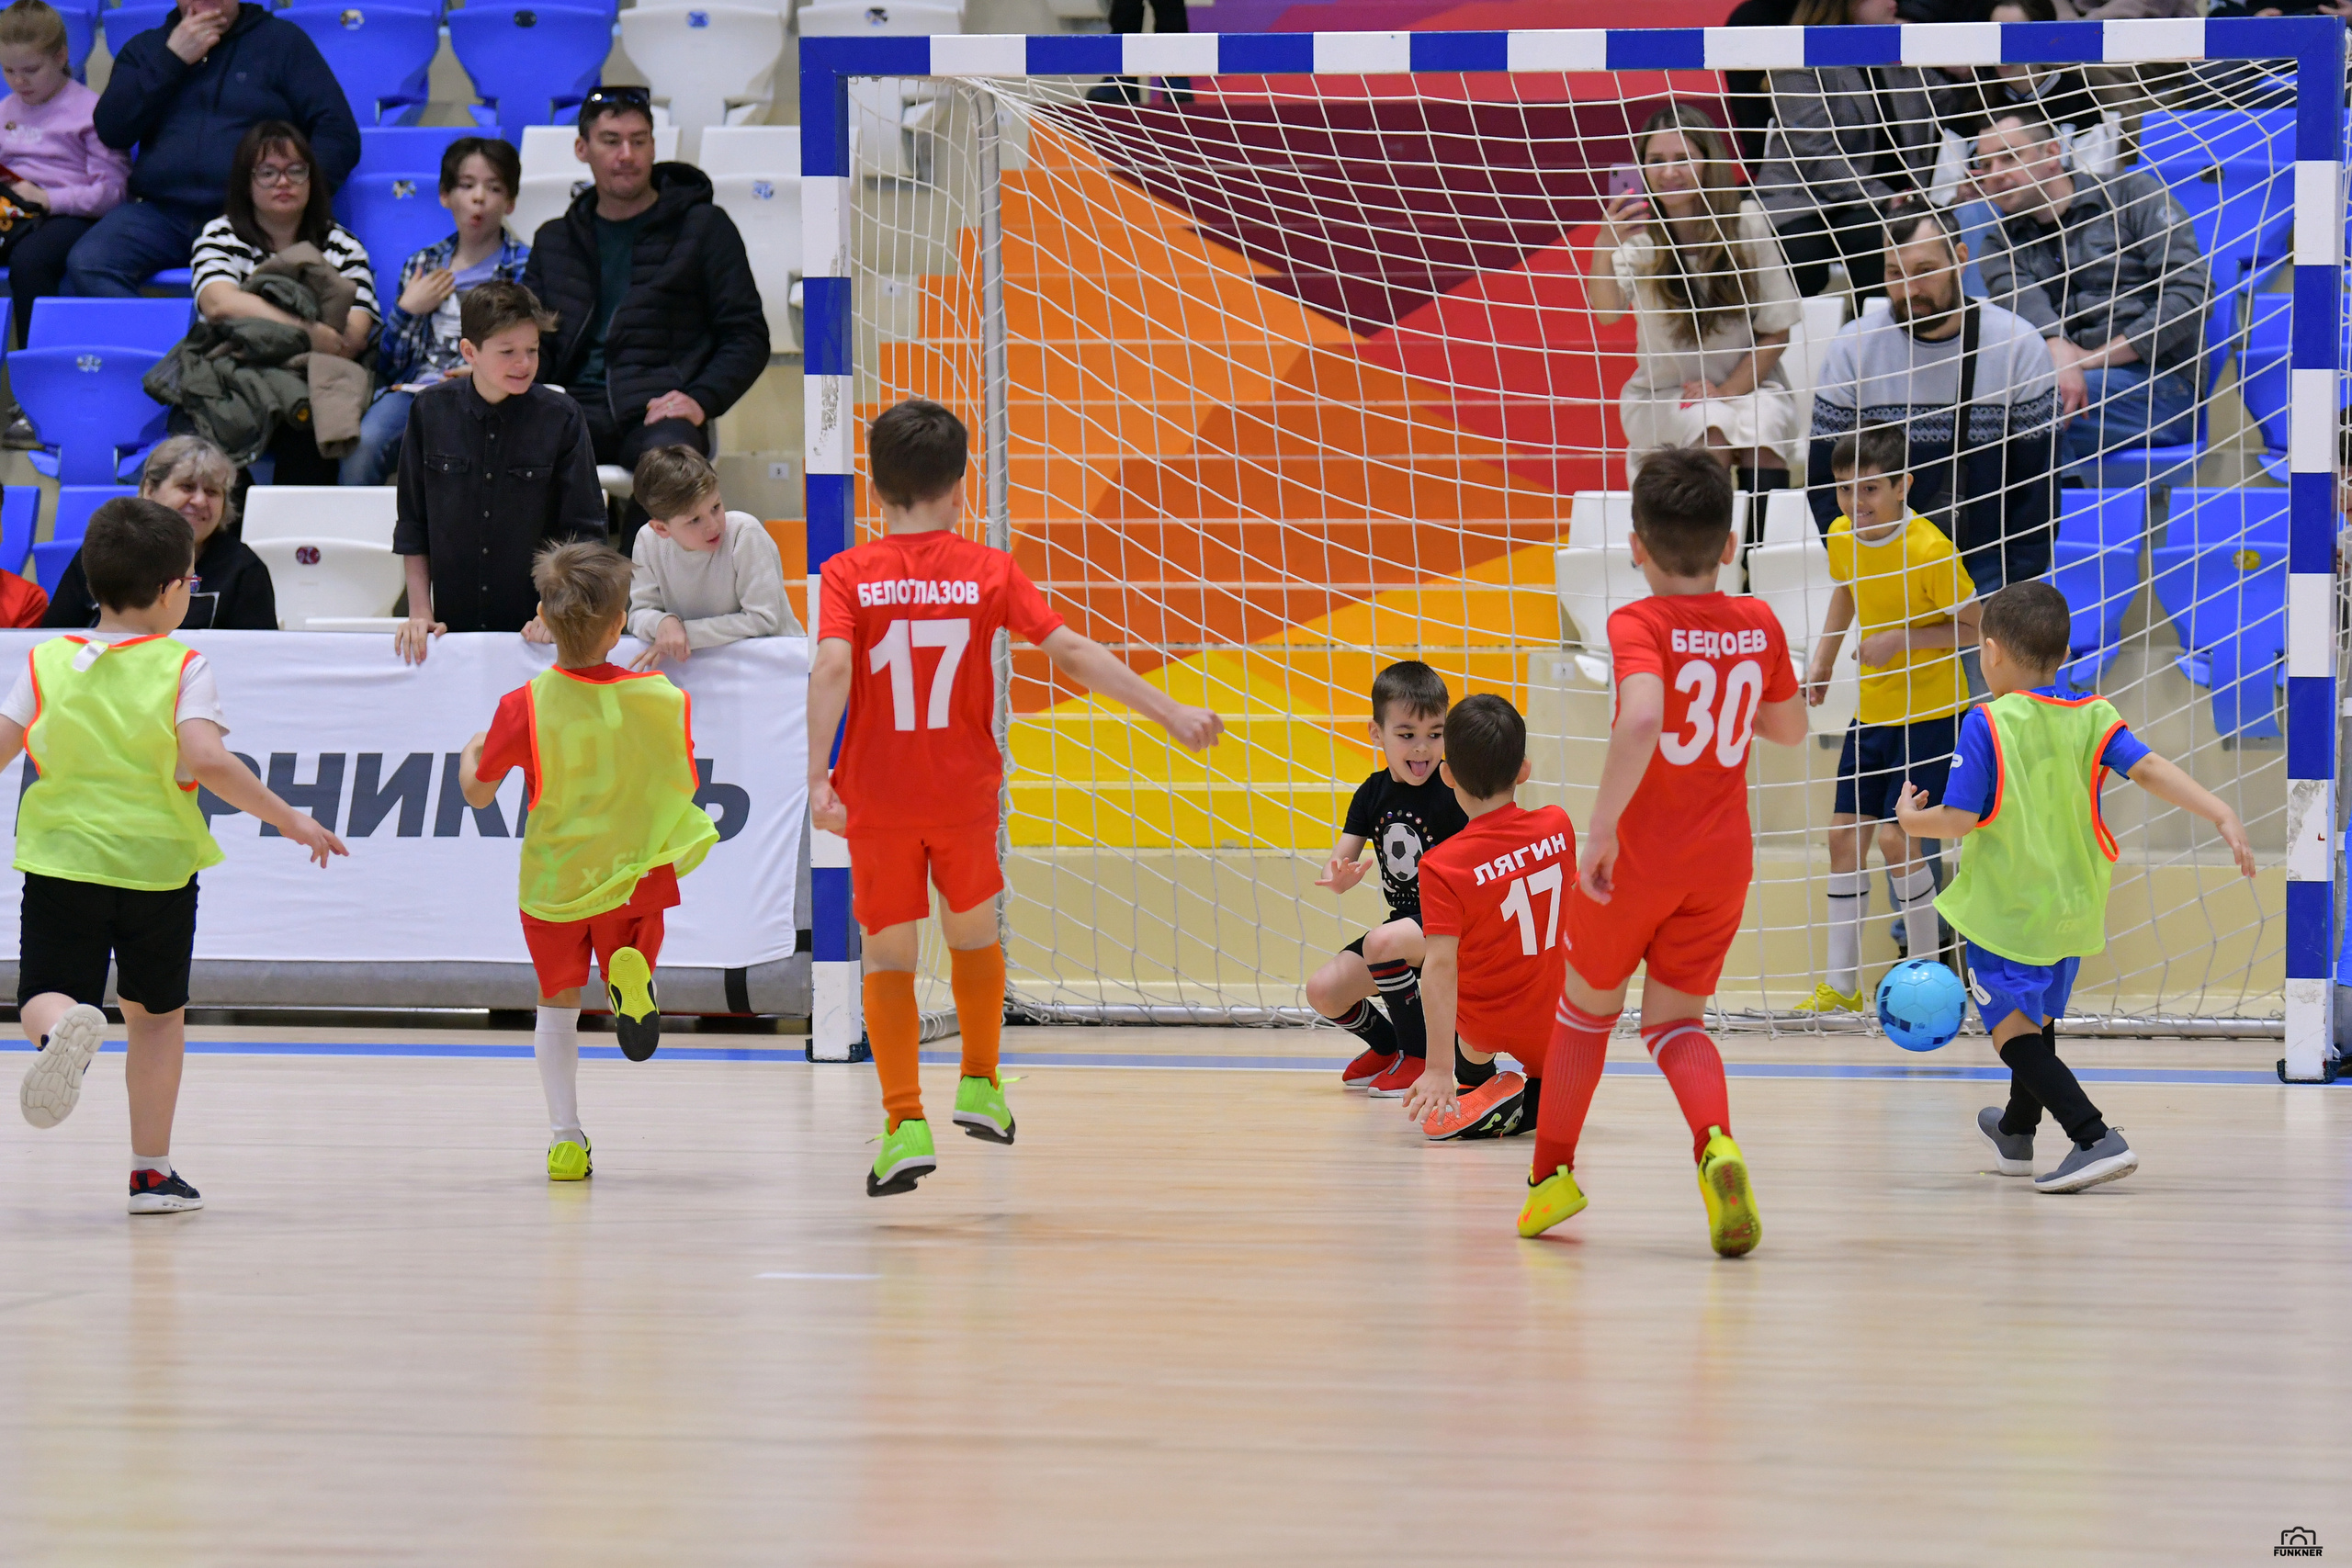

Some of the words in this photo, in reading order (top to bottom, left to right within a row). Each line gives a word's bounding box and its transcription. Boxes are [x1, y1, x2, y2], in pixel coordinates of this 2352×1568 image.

[868, 617, 971, 731] 17
[1671, 628, 1768, 660] БЕДОЕВ
[1658, 659, 1763, 768] 30
[1473, 832, 1567, 886] ЛЯГИН
[1499, 862, 1563, 956] 17
